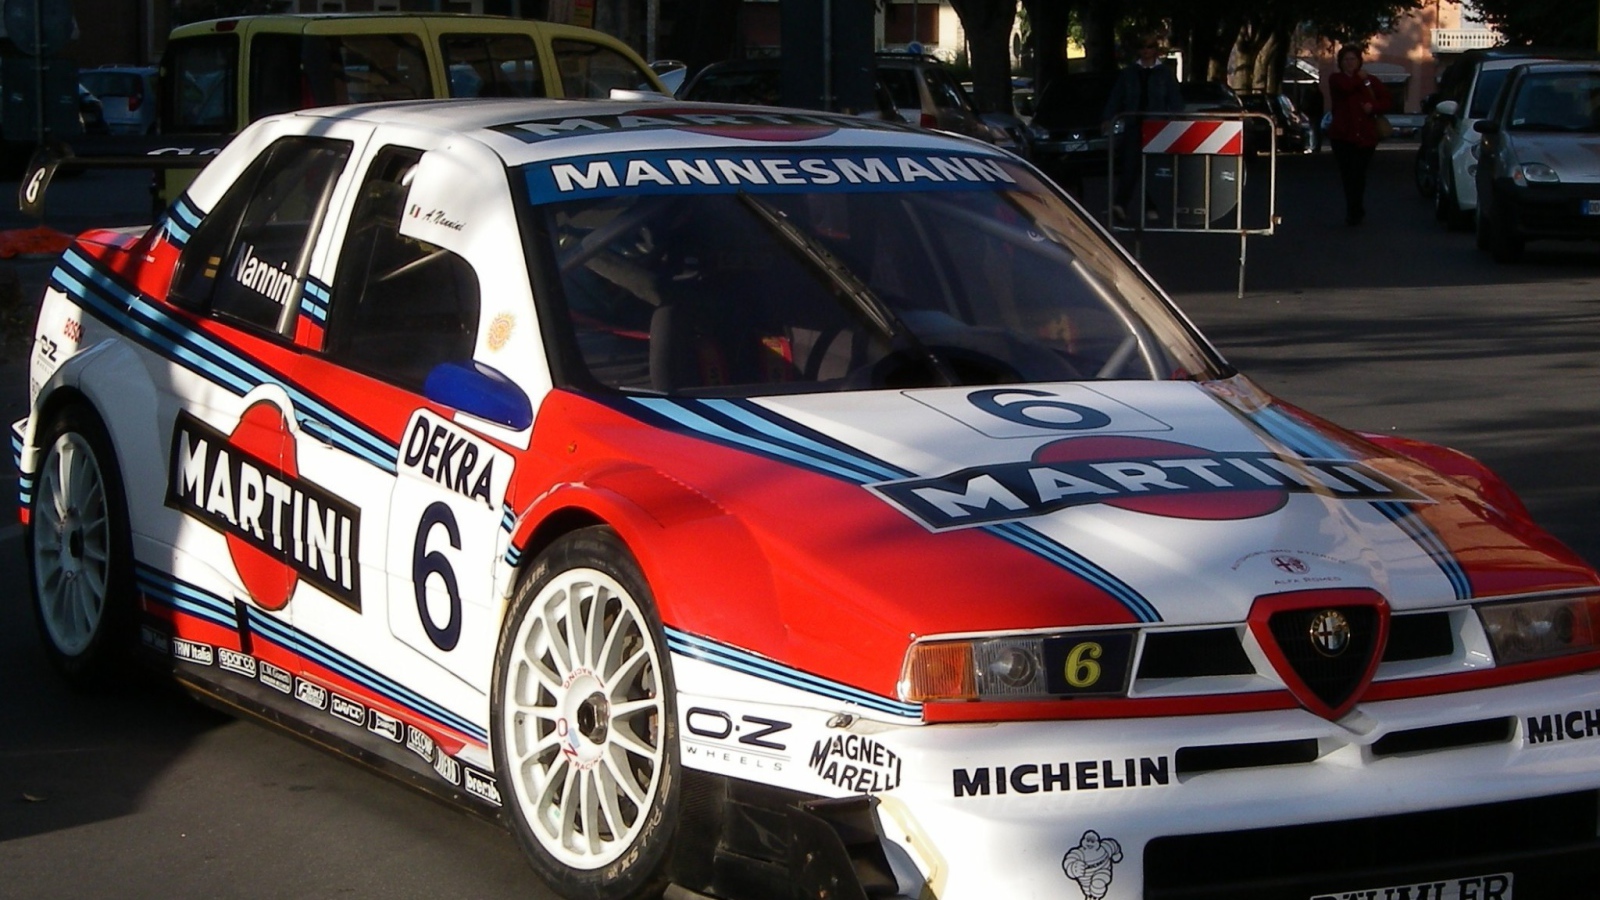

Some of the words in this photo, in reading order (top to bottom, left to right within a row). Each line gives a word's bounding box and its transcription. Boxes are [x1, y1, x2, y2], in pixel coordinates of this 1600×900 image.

[26, 167, 46, 203] 6
[550, 156, 1017, 193] MANNESMANN
[231, 241, 298, 305] Nannin
[63, 317, 85, 344] BOSCH
[966, 388, 1112, 431] 6
[404, 414, 496, 512] DEKRA
[910, 457, 1393, 518] MARTINI
[177, 428, 353, 591] MARTINI
[412, 500, 463, 653] 6
[173, 640, 191, 658] TRW
[190, 643, 212, 663] Italia
[219, 649, 256, 669] sparco
[1064, 641, 1103, 688] 6
[1527, 708, 1600, 745] MICH
[686, 745, 783, 772] WHEELS
[808, 734, 902, 785] MAGNETI
[952, 755, 1170, 798] MICHELIN
